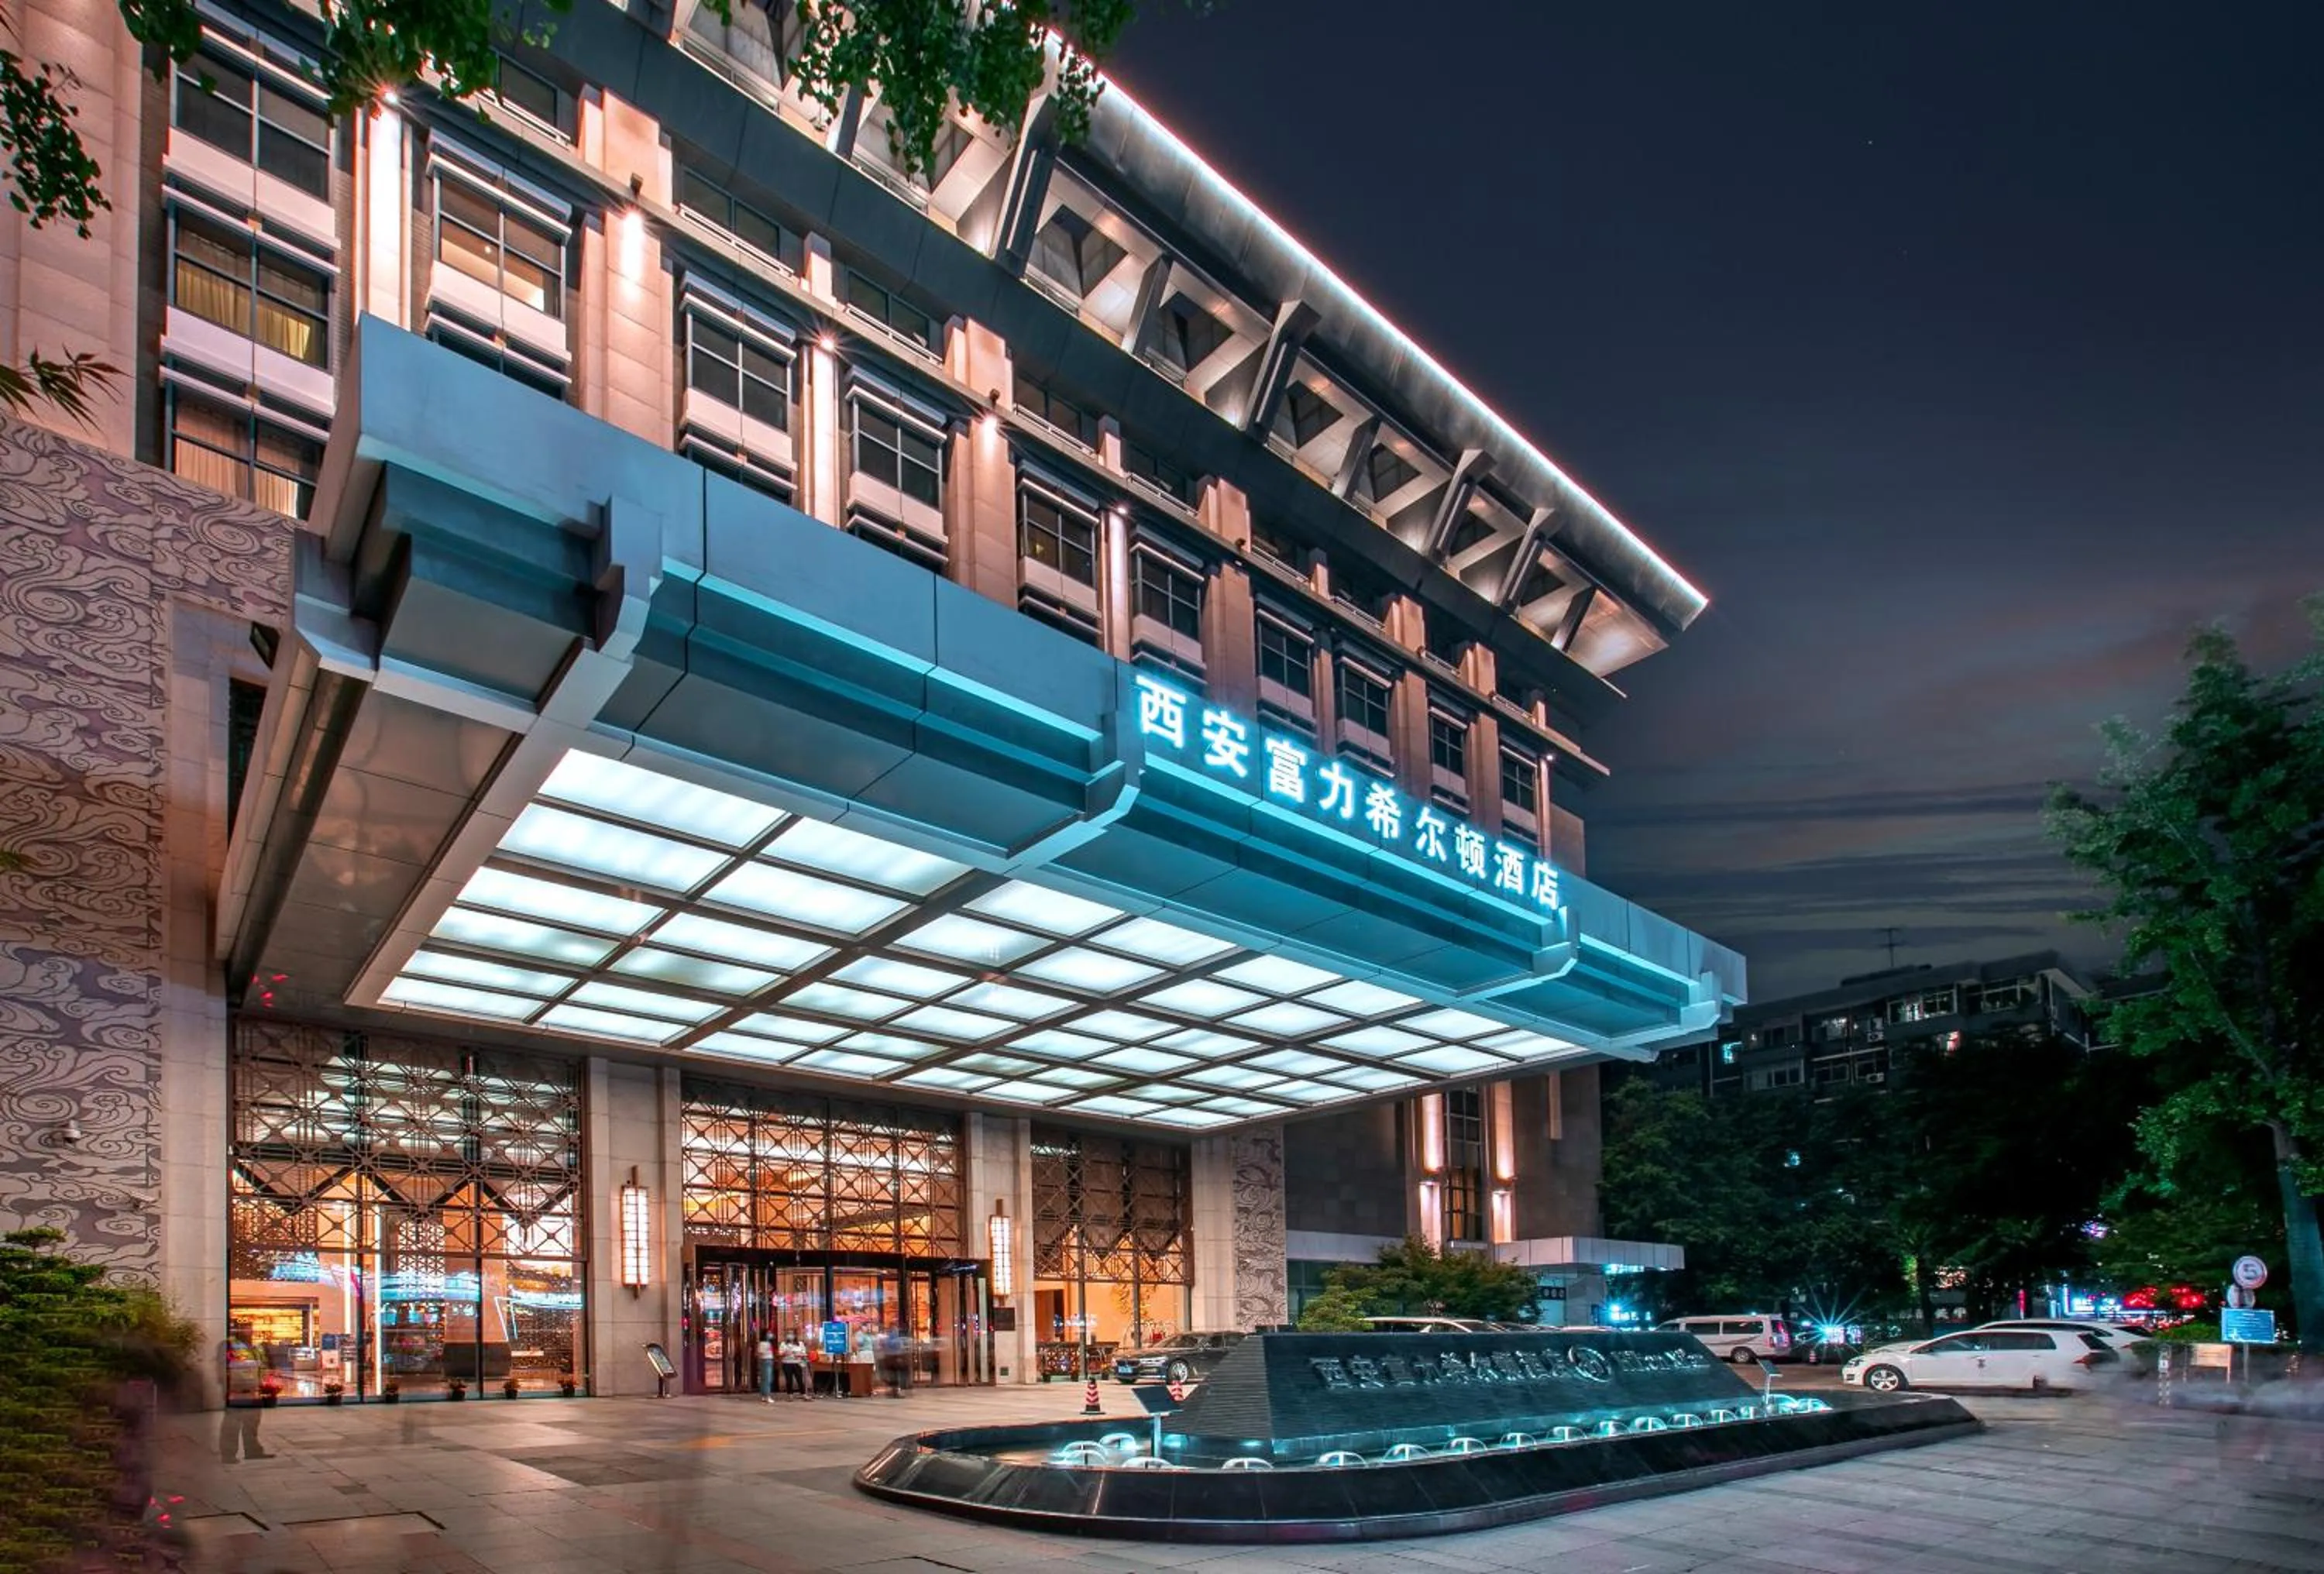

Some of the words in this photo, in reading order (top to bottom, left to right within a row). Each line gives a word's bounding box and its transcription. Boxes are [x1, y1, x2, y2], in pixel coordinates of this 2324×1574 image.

[1135, 674, 1559, 910] 西安富力希尔顿酒店
